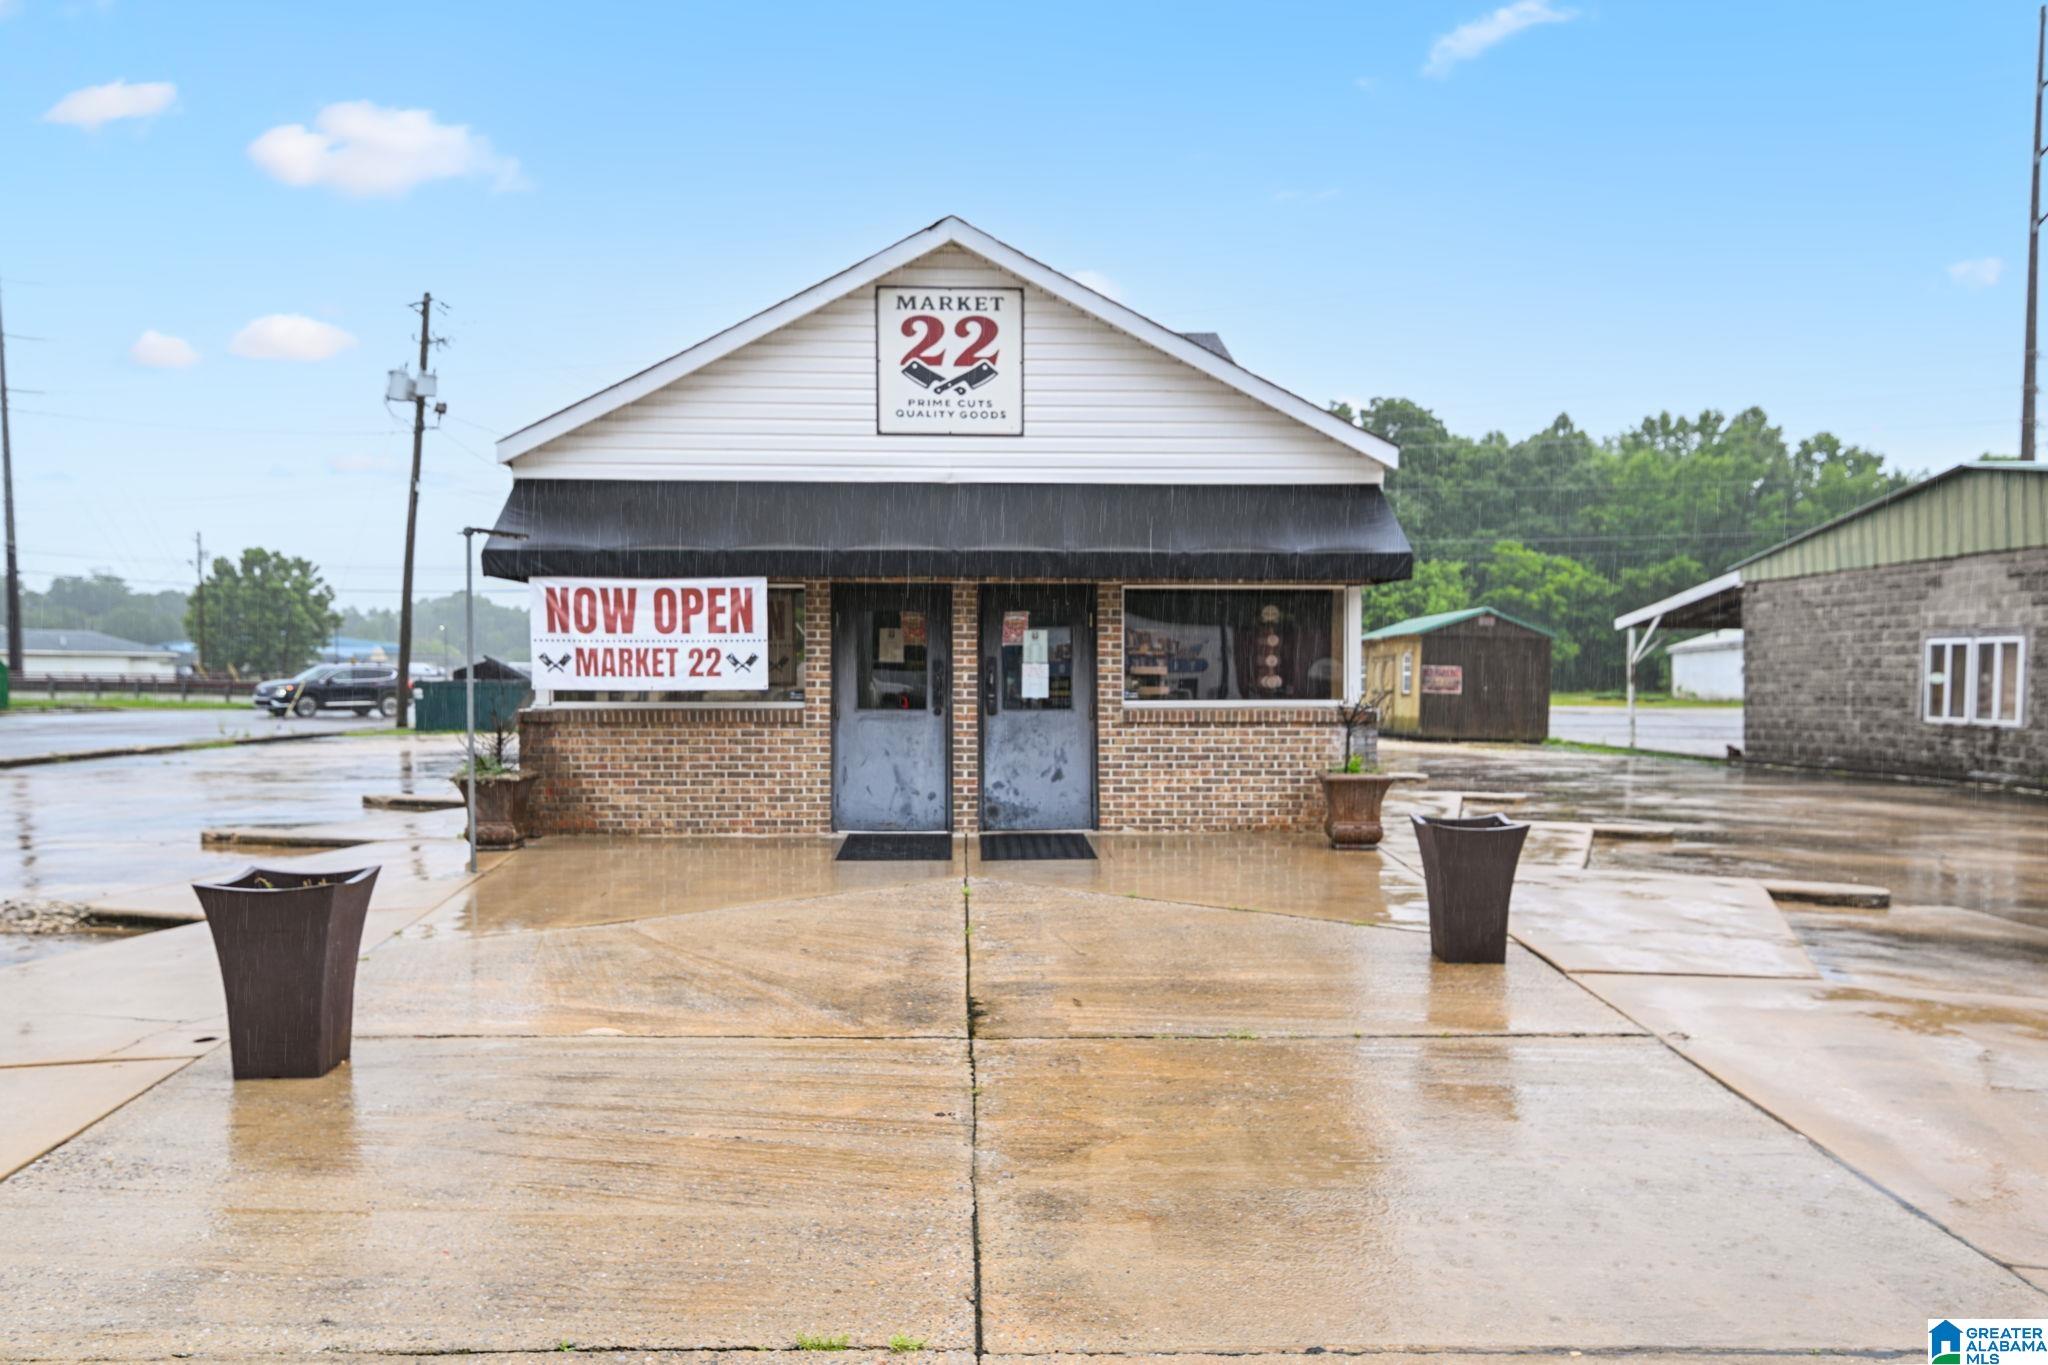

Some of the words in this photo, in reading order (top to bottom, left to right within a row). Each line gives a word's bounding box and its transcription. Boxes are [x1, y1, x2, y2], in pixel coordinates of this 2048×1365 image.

[896, 295, 1005, 312] MARKET
[900, 314, 1000, 367] 22
[896, 409, 954, 419] QUALITY
[960, 410, 1007, 419] GOODS
[908, 399, 950, 408] PRIME
[957, 399, 993, 408] CUTS
[545, 587, 637, 634] NOW
[653, 587, 754, 634] OPEN
[575, 647, 679, 677] MARKET
[688, 648, 722, 677] 22
